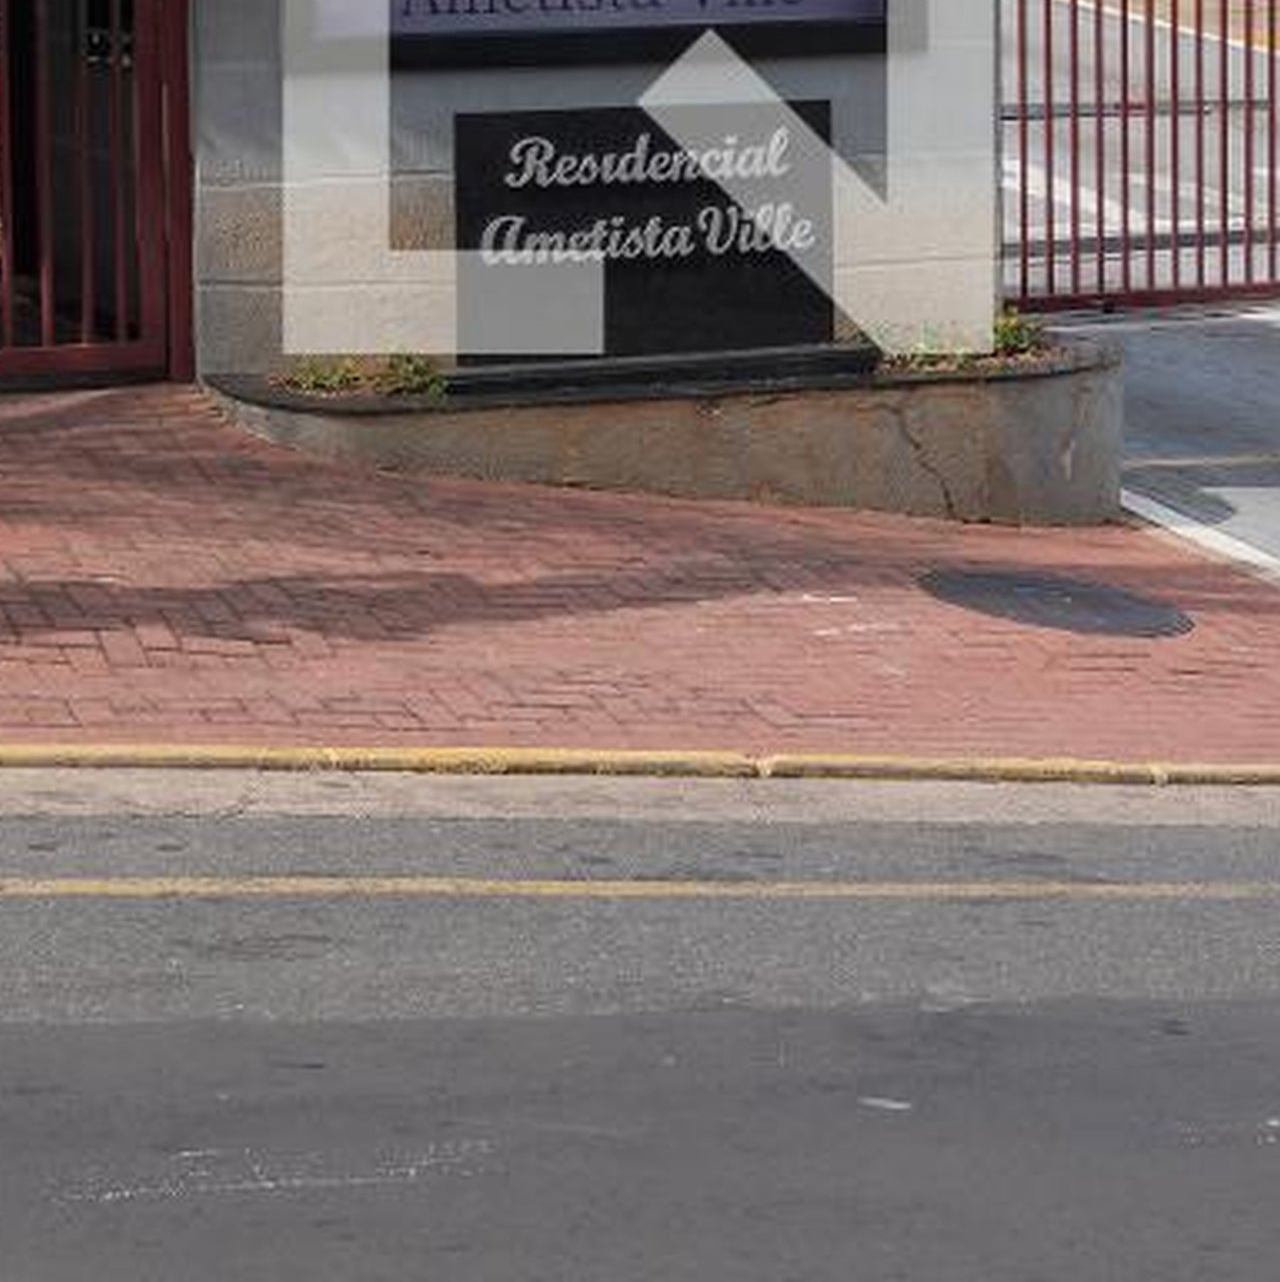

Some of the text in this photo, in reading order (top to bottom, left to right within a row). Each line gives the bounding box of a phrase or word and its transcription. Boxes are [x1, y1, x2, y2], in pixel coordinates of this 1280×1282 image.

[504, 125, 791, 188] Residencial
[481, 203, 816, 265] Ametista Ville
